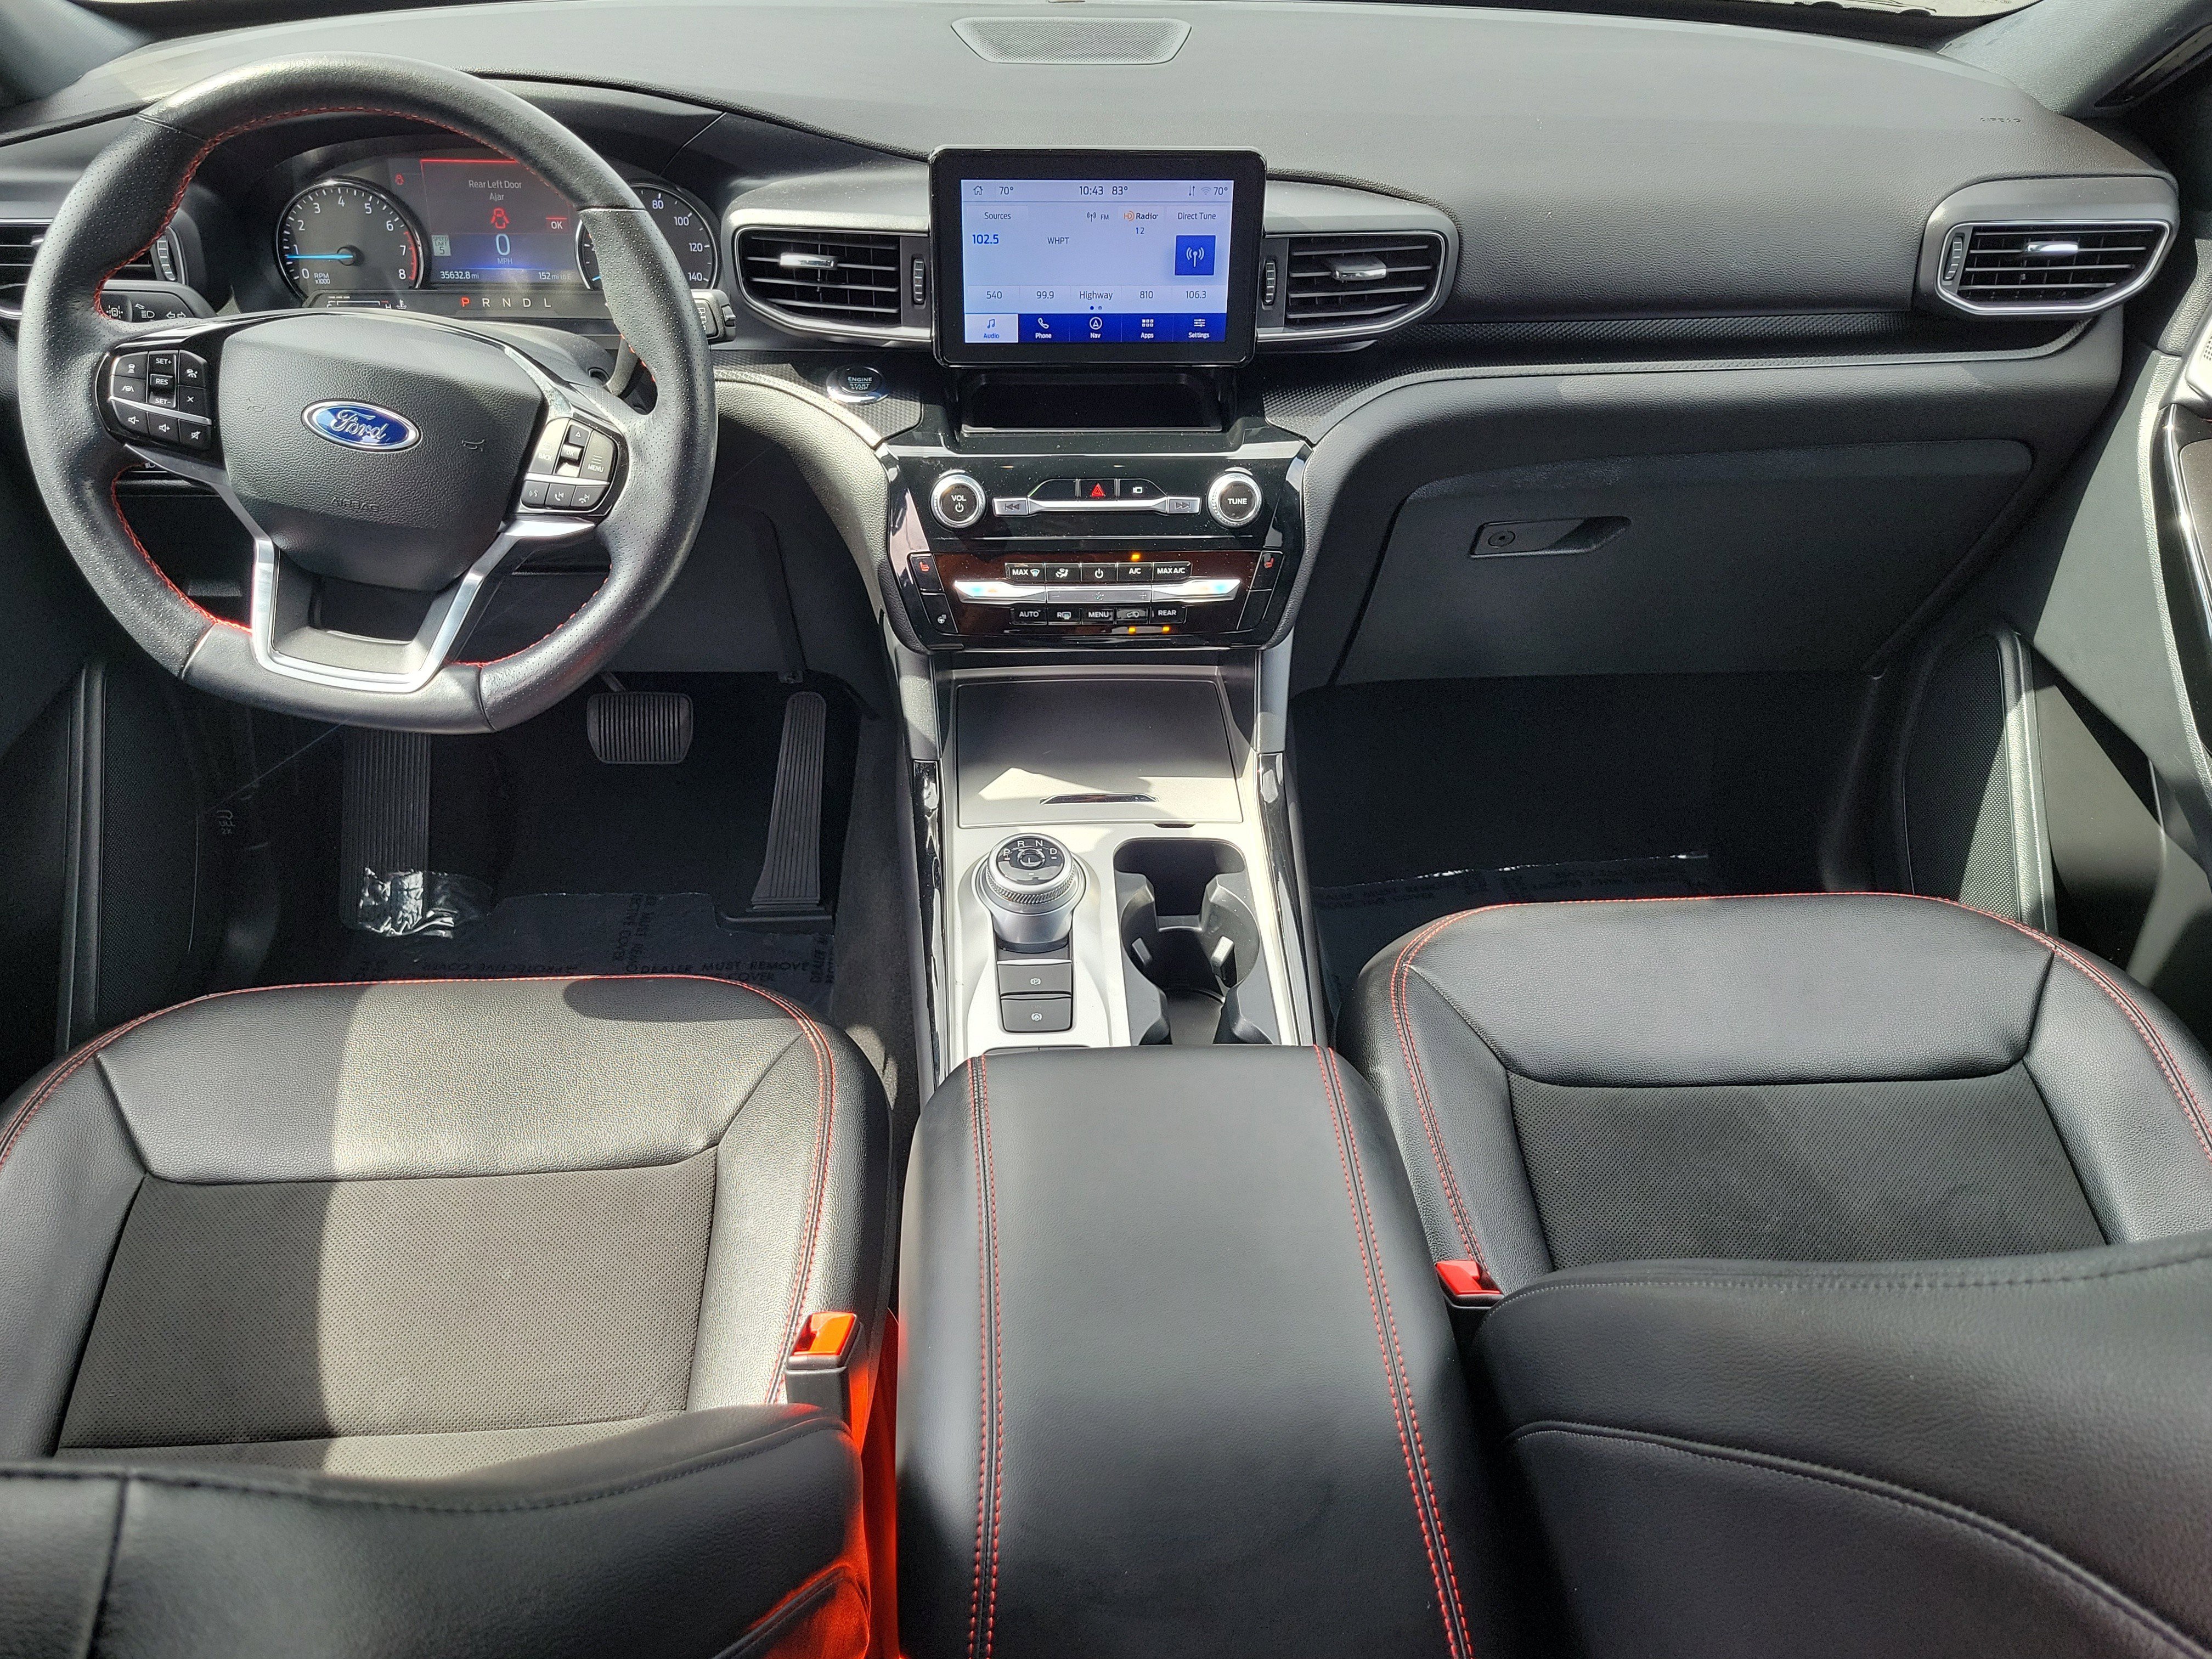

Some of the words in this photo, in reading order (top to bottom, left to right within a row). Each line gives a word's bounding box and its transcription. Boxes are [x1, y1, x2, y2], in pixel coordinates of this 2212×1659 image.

[469, 180, 486, 188] Rear
[488, 180, 503, 188] Left
[504, 180, 522, 189] Door
[999, 186, 1014, 195] 70°
[1079, 186, 1103, 195] 10:43
[1111, 186, 1128, 195] 83°
[1214, 187, 1228, 195] 70°
[337, 195, 345, 207] 4
[489, 193, 504, 201] Ajar
[313, 202, 321, 213] 3
[364, 203, 372, 215] 5
[652, 200, 664, 209] 80
[297, 220, 306, 231] 2
[386, 220, 394, 232] 6
[551, 221, 563, 229] OK
[674, 216, 689, 226] 100
[972, 234, 999, 244] 102.5
[293, 244, 299, 255] 1
[496, 233, 511, 256] 0
[689, 242, 703, 252] 120
[399, 245, 407, 256] 7
[439, 246, 445, 255] 5
[302, 268, 309, 279] 0
[398, 269, 406, 280] 8
[688, 272, 703, 281] 140
[986, 291, 1002, 299] 540
[1036, 291, 1054, 299] 99.9
[1079, 291, 1113, 301] Highway
[461, 297, 470, 307] P
[482, 298, 490, 307] R
[503, 298, 511, 307] N
[523, 298, 531, 307] D
[544, 298, 551, 307] L
[330, 409, 389, 440] Ford
[587, 464, 604, 473] MENU
[702, 960, 741, 972] MUST
[749, 960, 809, 972] REMOVE
